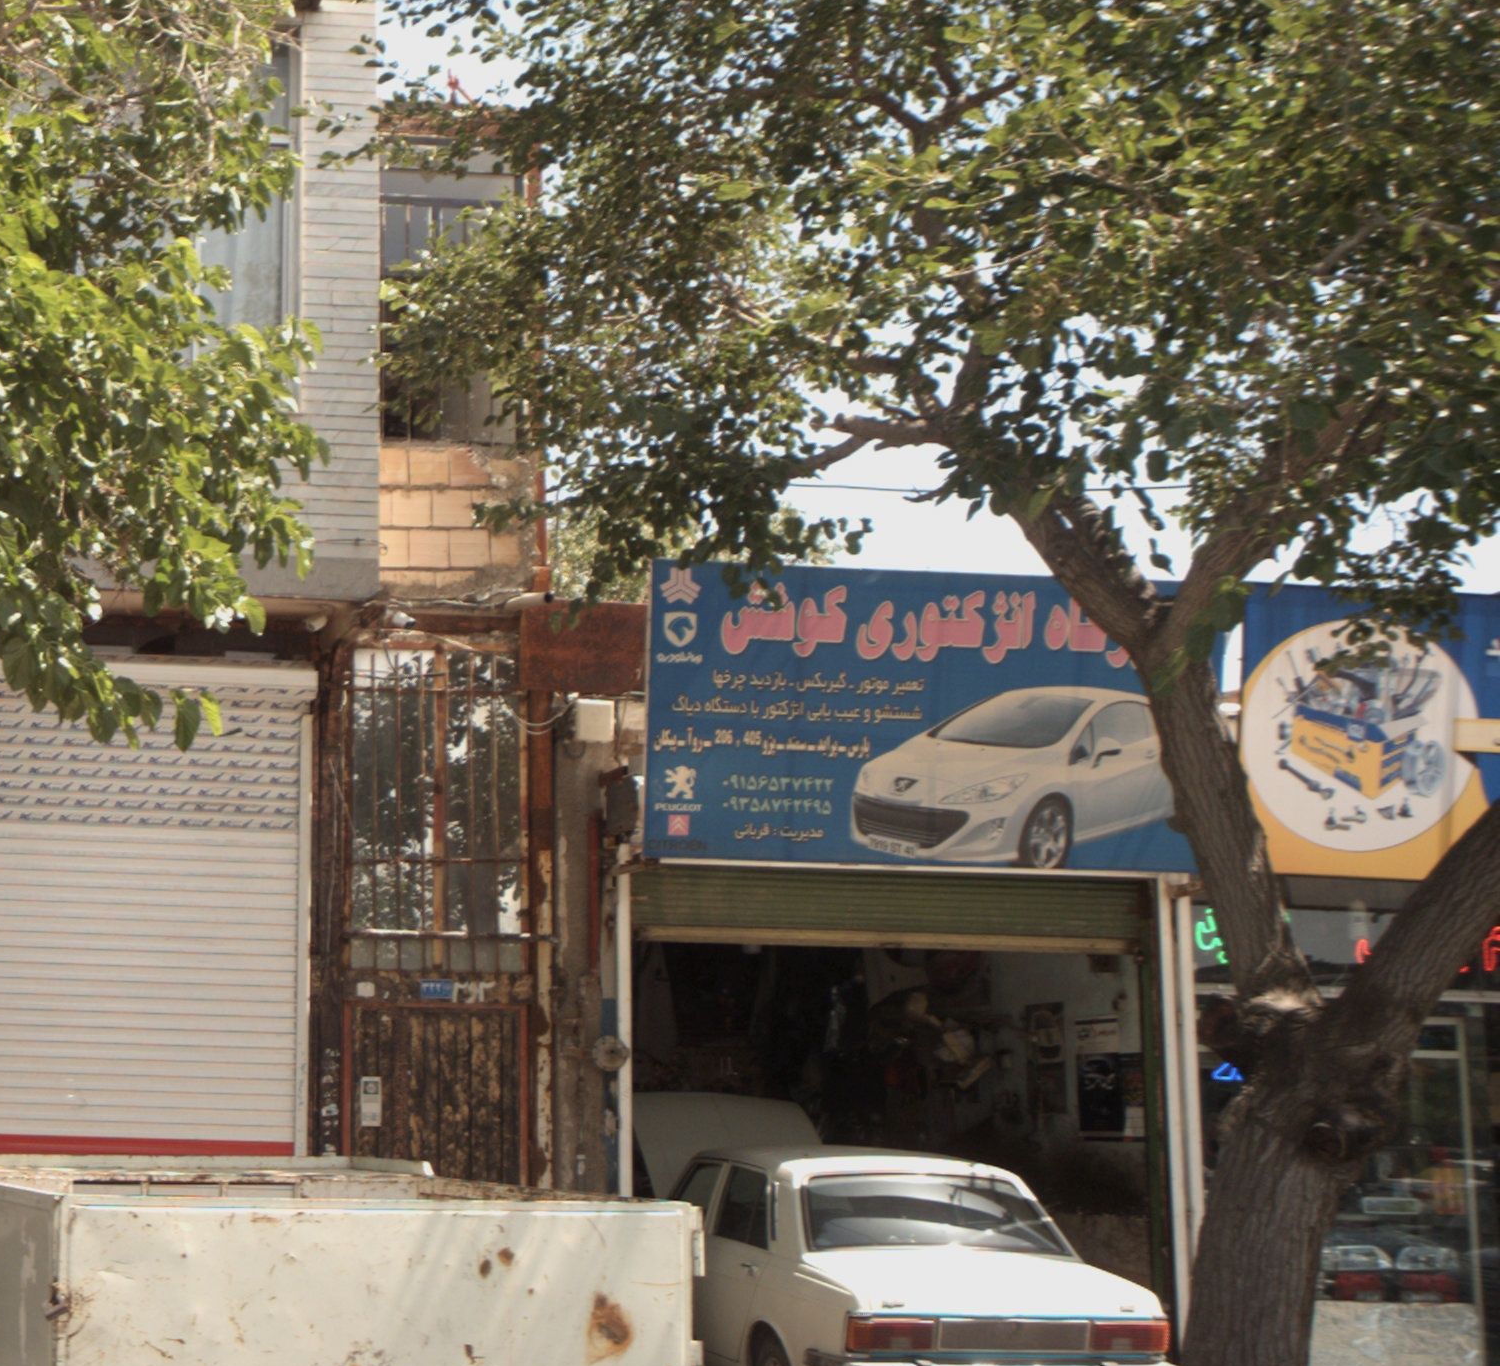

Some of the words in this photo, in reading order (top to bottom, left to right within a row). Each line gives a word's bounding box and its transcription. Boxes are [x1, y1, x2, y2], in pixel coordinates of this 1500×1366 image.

[856, 590, 1036, 664] انژکتوری
[856, 677, 890, 694] موتور
[891, 678, 925, 695] تعمیر
[873, 704, 923, 723] شستشو
[654, 801, 703, 813] PEUGEOT
